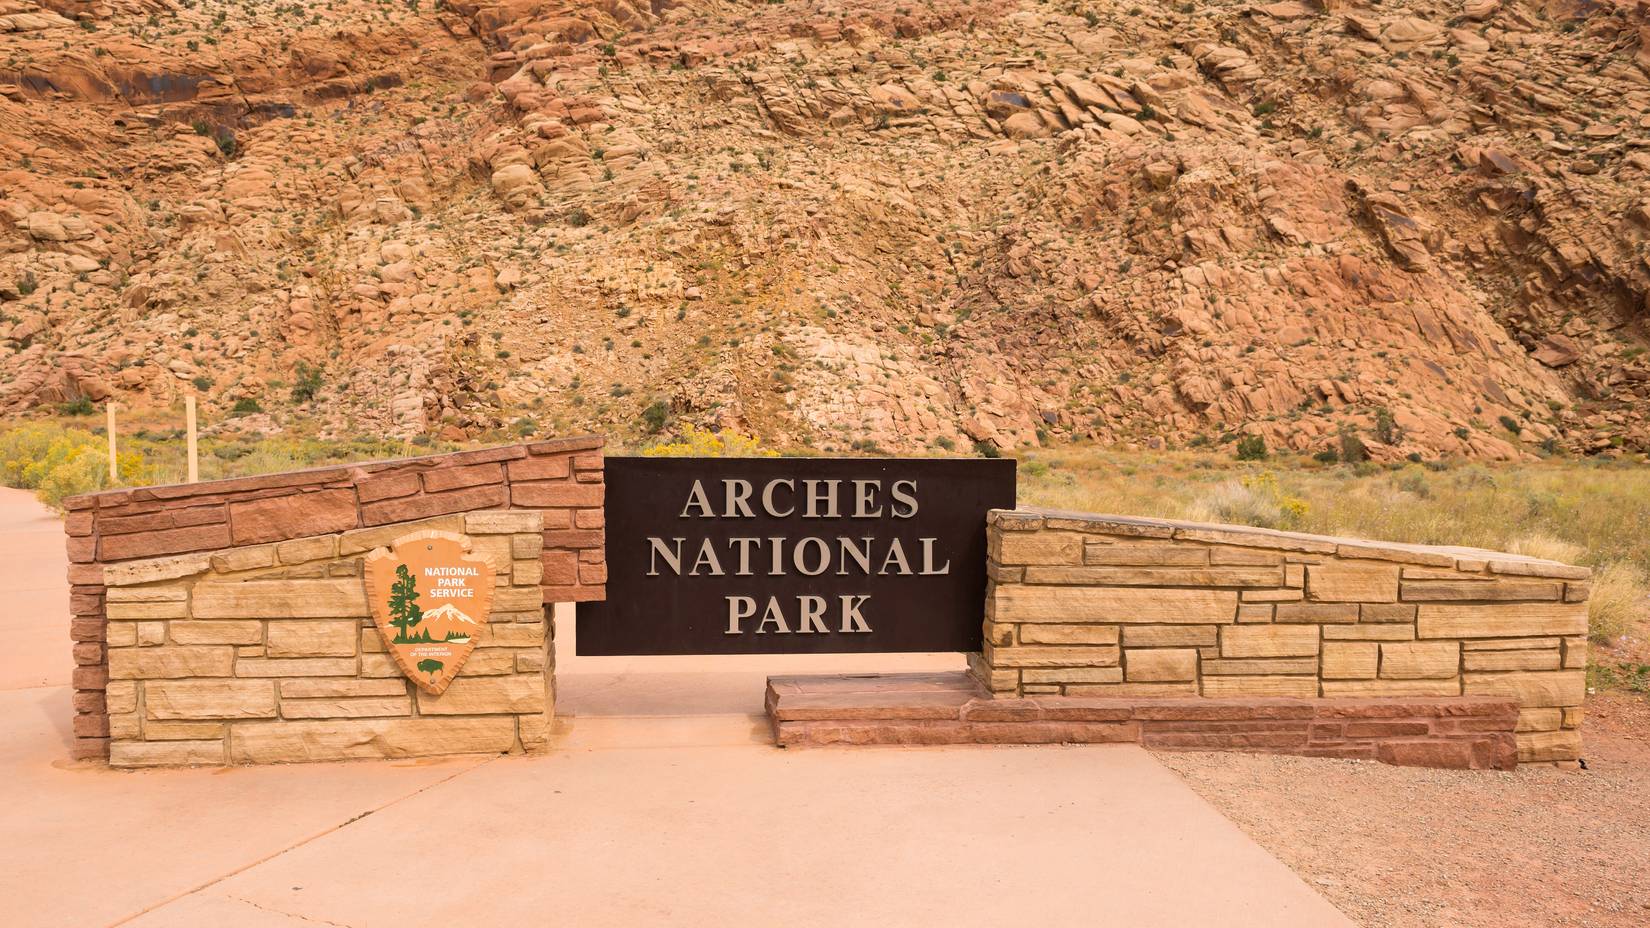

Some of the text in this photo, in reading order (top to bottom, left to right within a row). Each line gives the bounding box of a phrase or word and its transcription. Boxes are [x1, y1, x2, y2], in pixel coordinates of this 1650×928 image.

[680, 478, 919, 518] ARCHES
[646, 537, 950, 576] NATIONAL
[425, 567, 478, 576] NATIONAL
[438, 579, 465, 587] PARK
[430, 589, 474, 598] SERVICE
[724, 595, 873, 634] PARK
